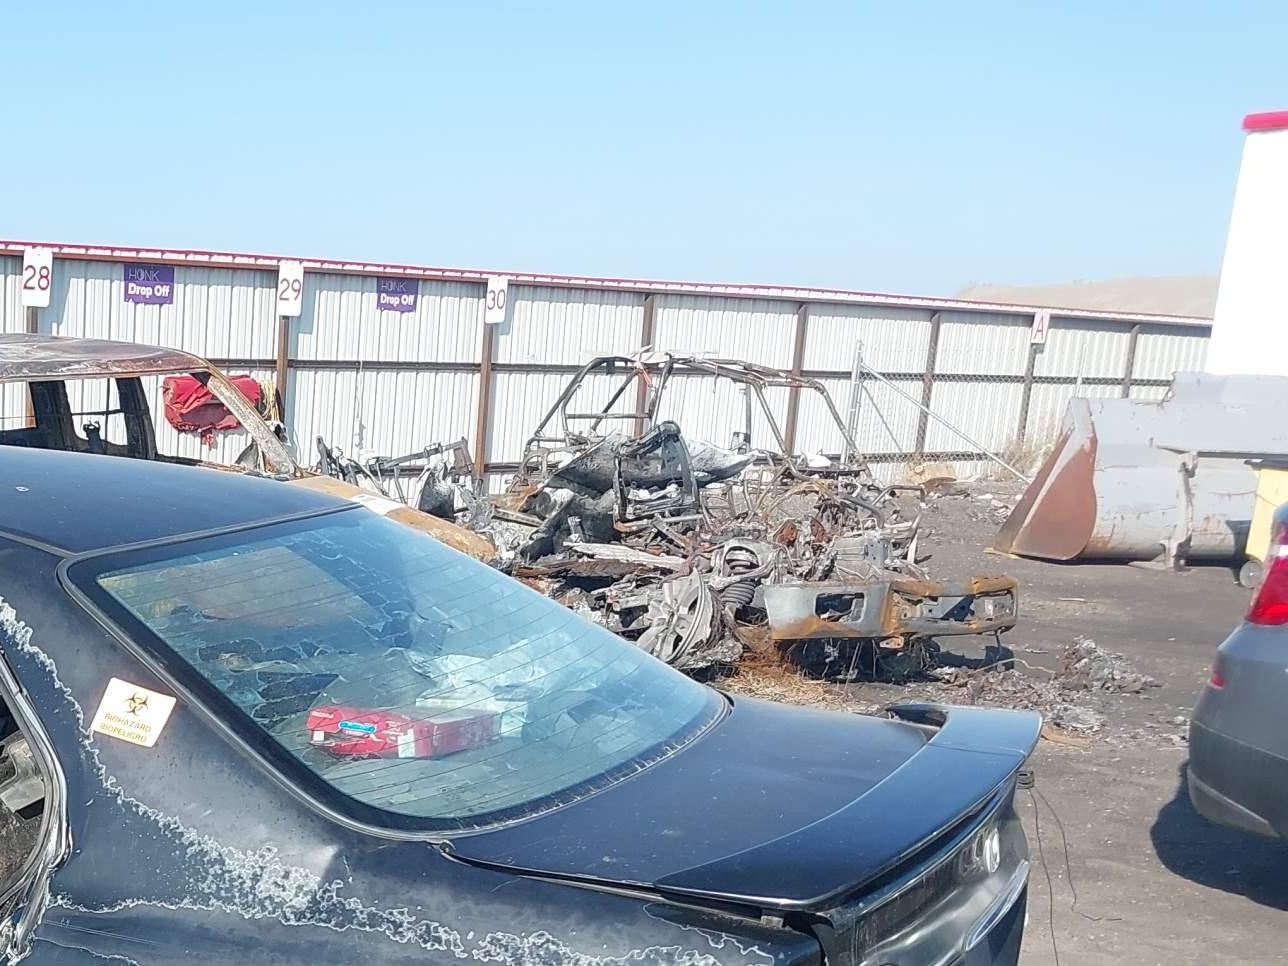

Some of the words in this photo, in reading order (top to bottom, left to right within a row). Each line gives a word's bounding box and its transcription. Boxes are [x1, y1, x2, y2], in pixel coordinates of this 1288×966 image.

[23, 264, 50, 290] 28
[128, 268, 160, 281] HONK
[128, 282, 153, 298] Drop
[154, 284, 170, 297] Off
[279, 278, 302, 301] 29
[381, 280, 407, 292] HONK
[380, 293, 400, 307] Drop
[401, 294, 415, 306] Off
[487, 289, 506, 310] 30
[1033, 314, 1044, 341] A
[99, 722, 148, 742] BIOPELIGRO
[104, 713, 152, 733] BIOHAZARD
